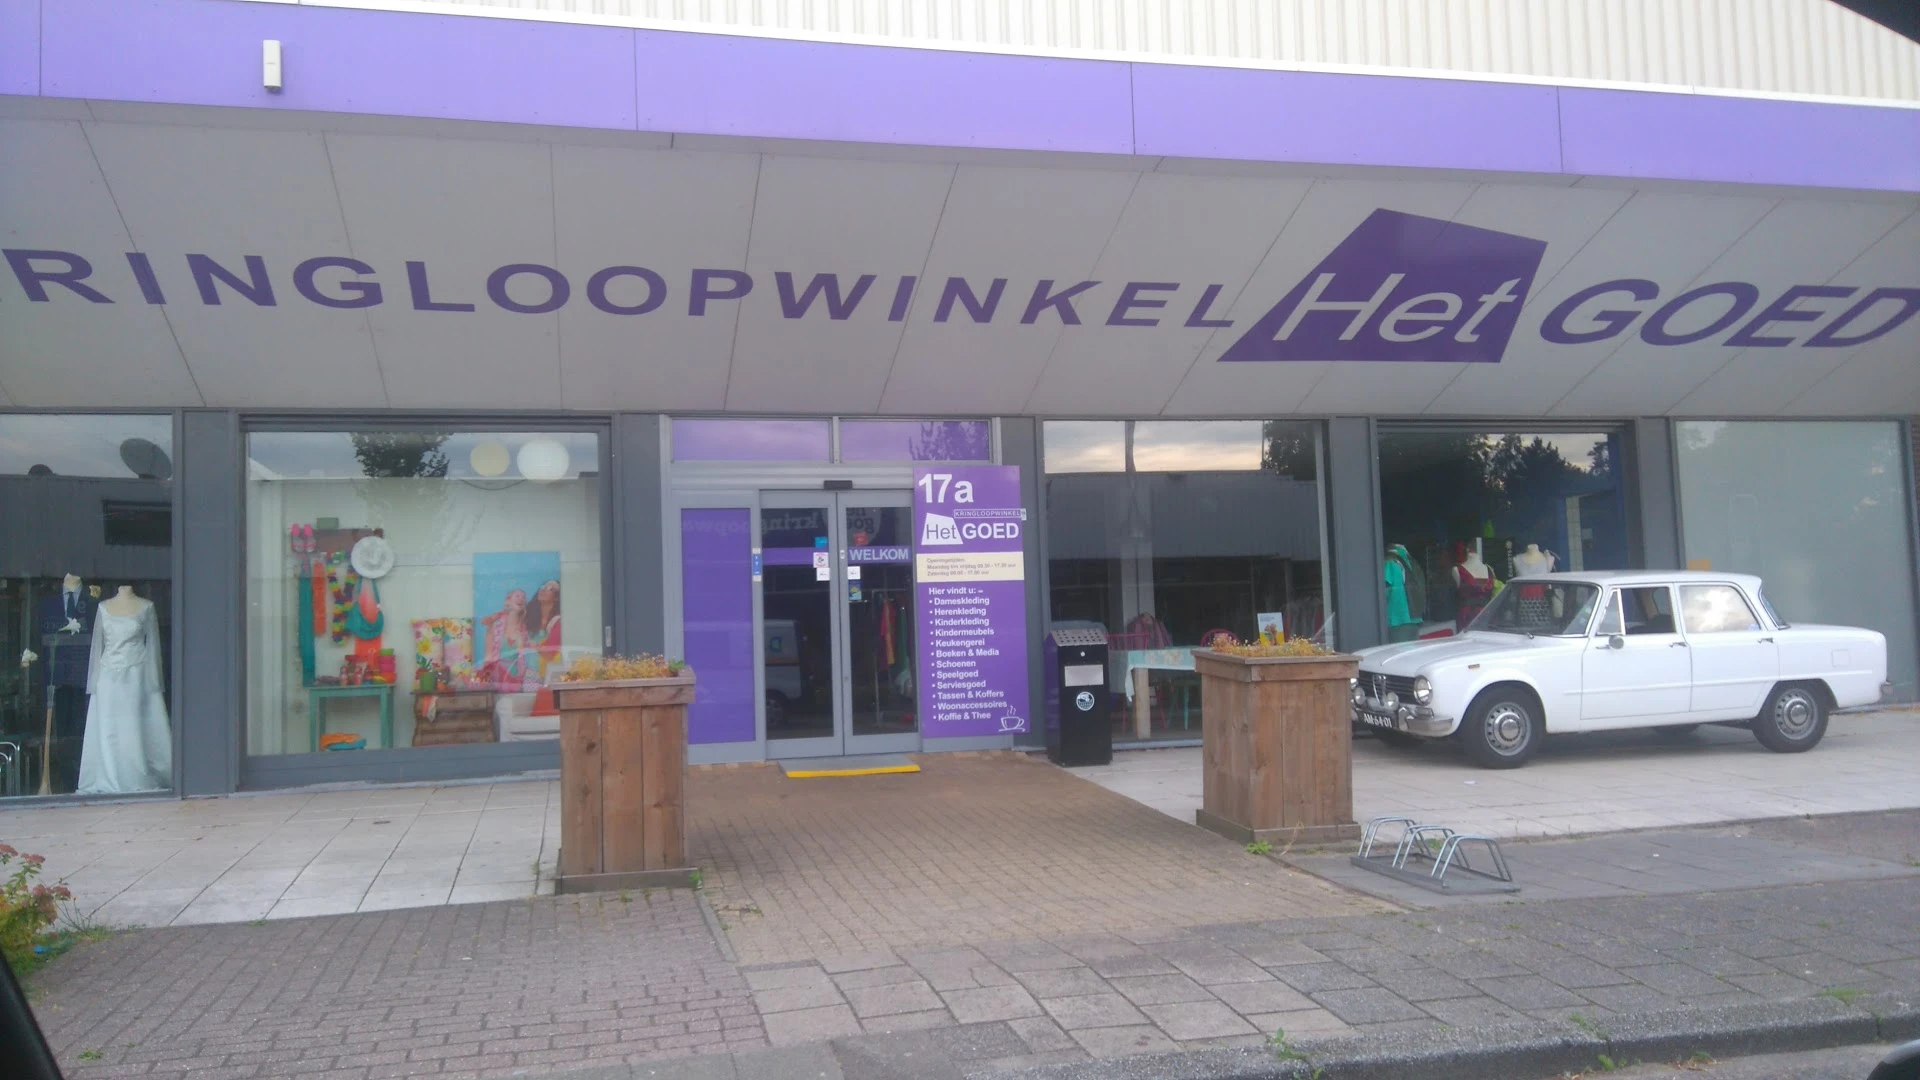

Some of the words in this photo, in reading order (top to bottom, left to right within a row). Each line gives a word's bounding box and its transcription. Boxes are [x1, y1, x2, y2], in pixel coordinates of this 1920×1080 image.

[0, 248, 1235, 327] RINGLOOPWINKEL
[1272, 272, 1522, 344] Het
[1539, 277, 1919, 347] GOED
[918, 473, 974, 504] 17a
[926, 524, 957, 540] Het
[962, 522, 1019, 539] GOED
[849, 548, 909, 561] WELKOM
[928, 587, 945, 595] Hier
[934, 597, 990, 606] Dameskleding
[934, 607, 987, 616] Herenkleding
[935, 618, 990, 627] Kinderkleding
[935, 628, 995, 637] Kindermeubels
[936, 638, 985, 648] Keukengerei
[936, 649, 966, 658] Boeken
[968, 649, 975, 657] &
[976, 648, 1000, 656] Media
[936, 660, 977, 668] Schoenen
[937, 670, 979, 679] Speelgoed
[937, 680, 987, 690] Serviesgoed
[937, 691, 966, 700] Tassen
[975, 690, 1004, 698] Koffers
[937, 700, 1008, 710] Woonaccessoires
[938, 712, 962, 721] Koffie
[963, 712, 970, 720] &
[971, 711, 992, 719] Thee
